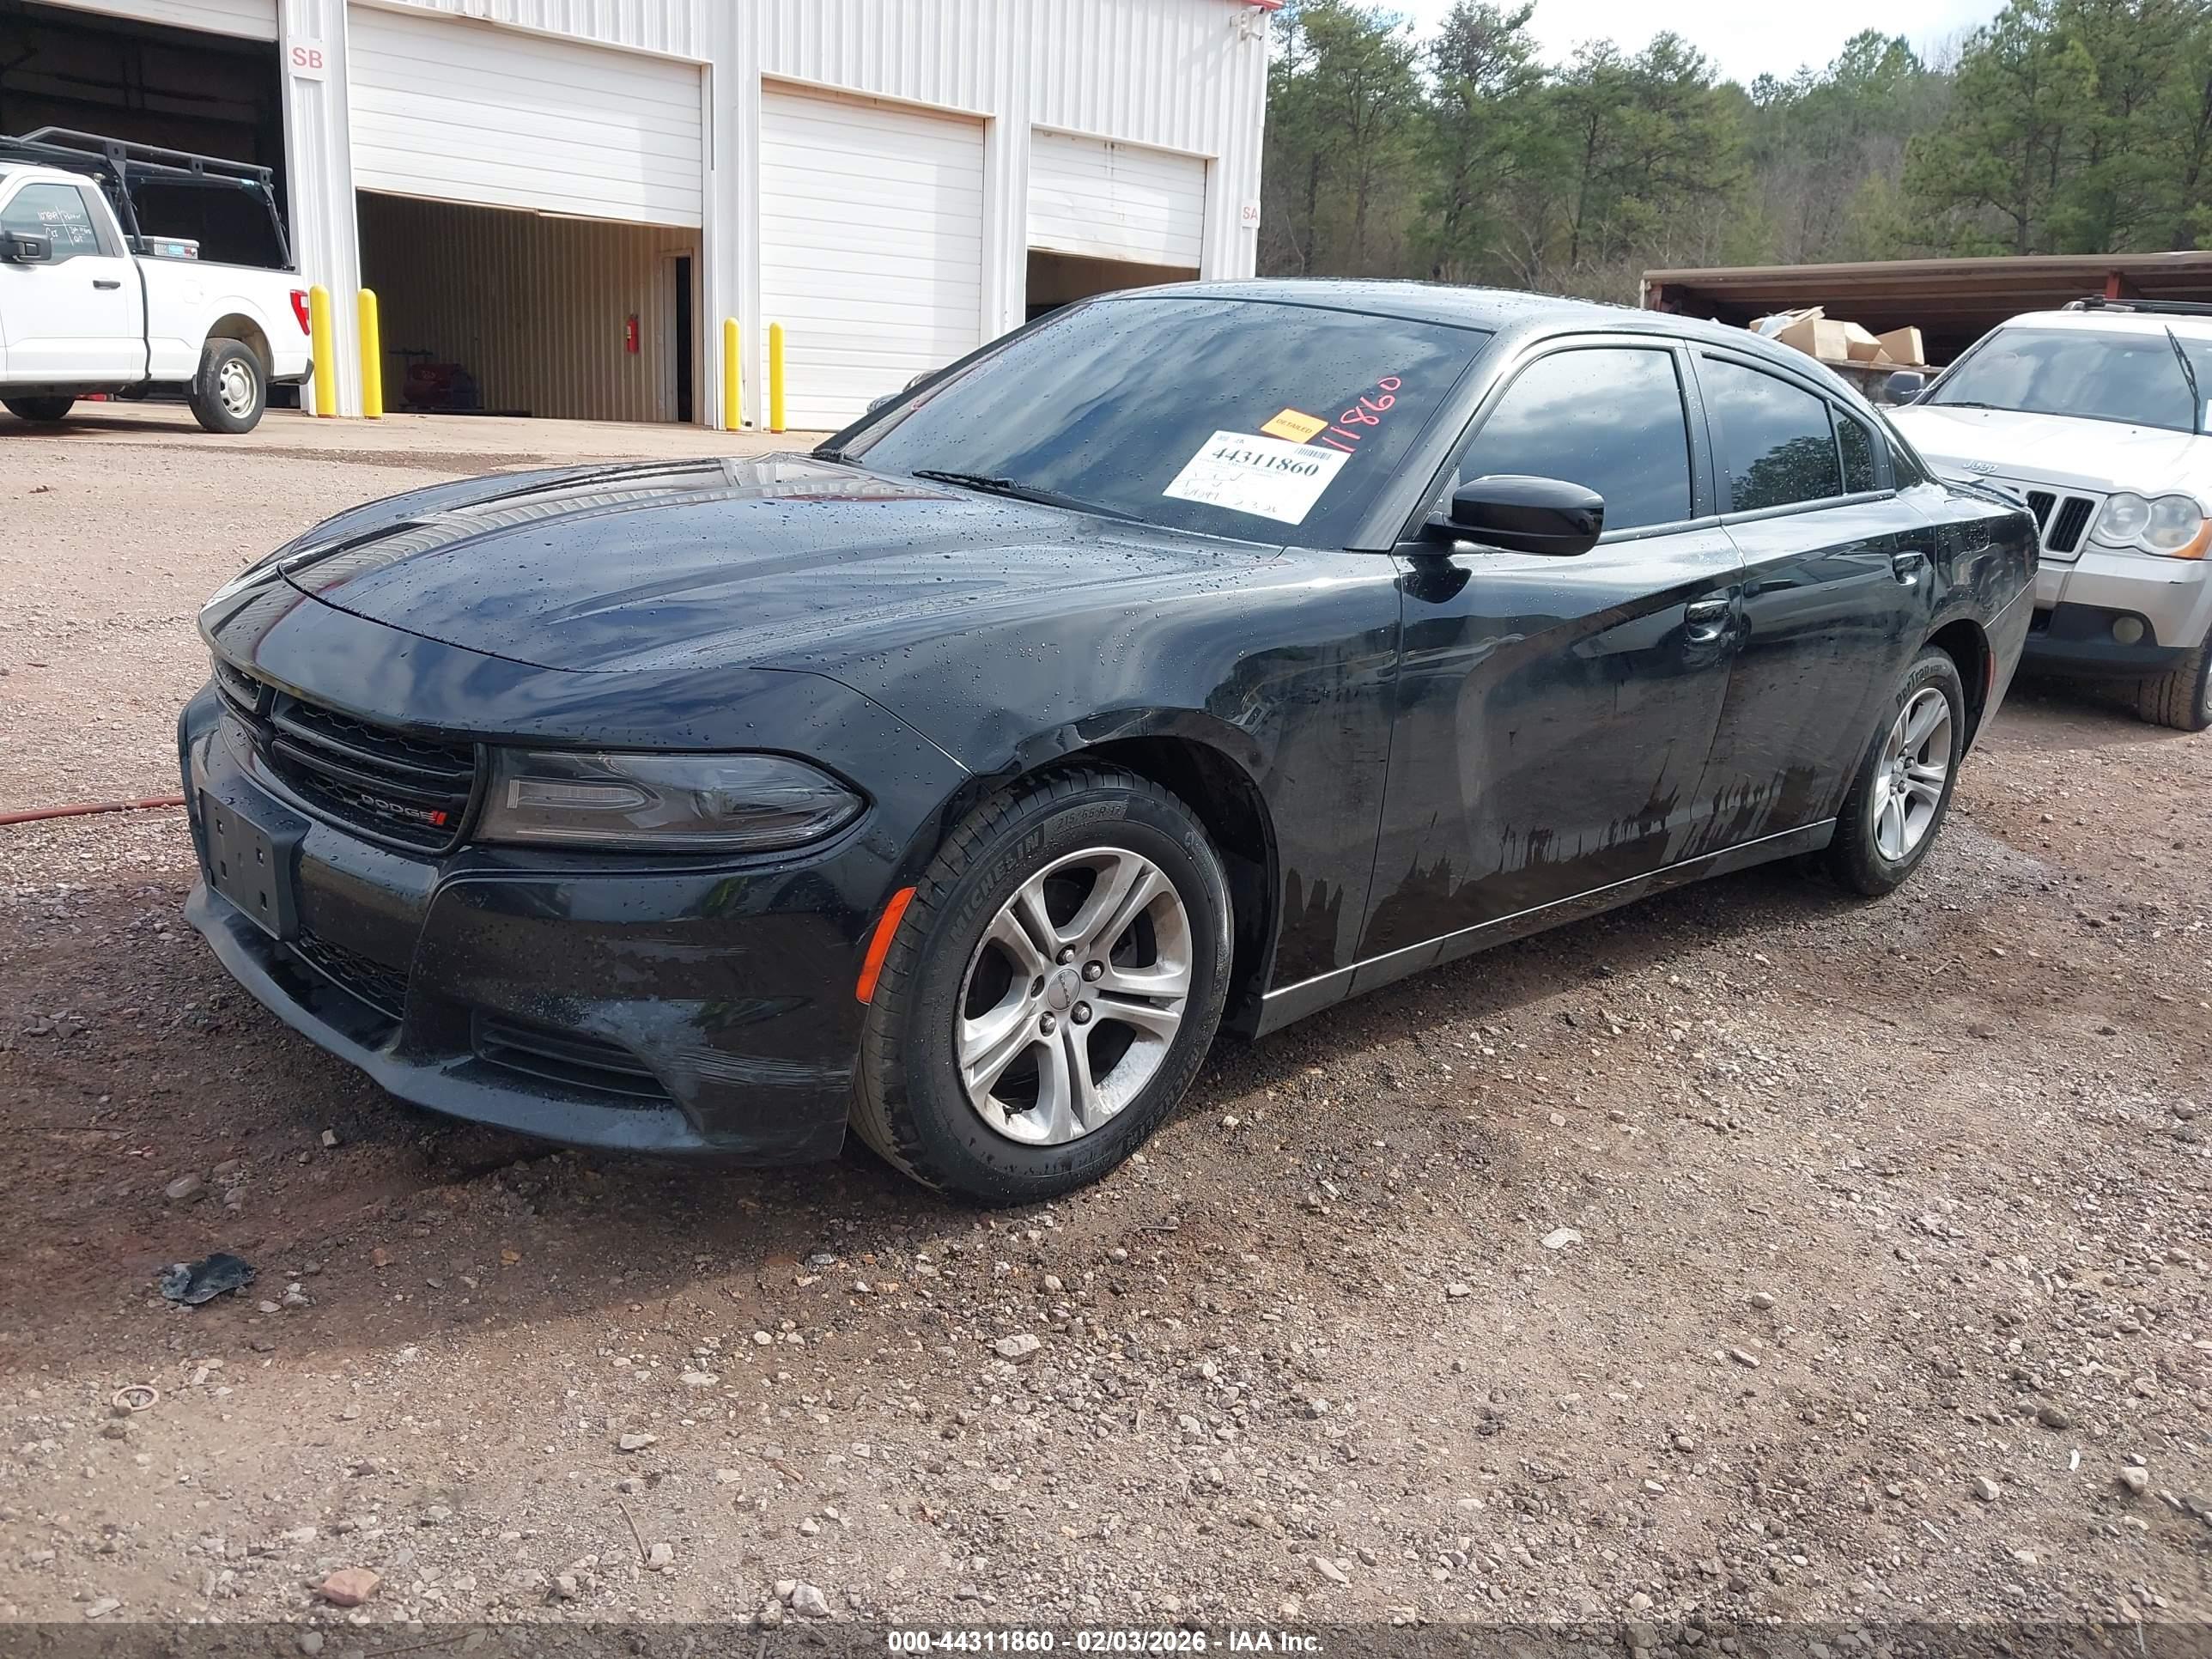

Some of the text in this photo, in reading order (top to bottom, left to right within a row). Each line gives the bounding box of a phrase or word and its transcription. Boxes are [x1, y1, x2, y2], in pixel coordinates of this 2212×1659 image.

[292, 46, 323, 69] SB
[1243, 206, 1258, 221] SA
[1275, 418, 1313, 434] DETAILED
[1322, 376, 1401, 453] 11860
[1212, 447, 1319, 477] 44311860
[1962, 459, 1999, 473] Jeep
[361, 793, 435, 821] DODGE
[949, 827, 1040, 944] MICHELIN
